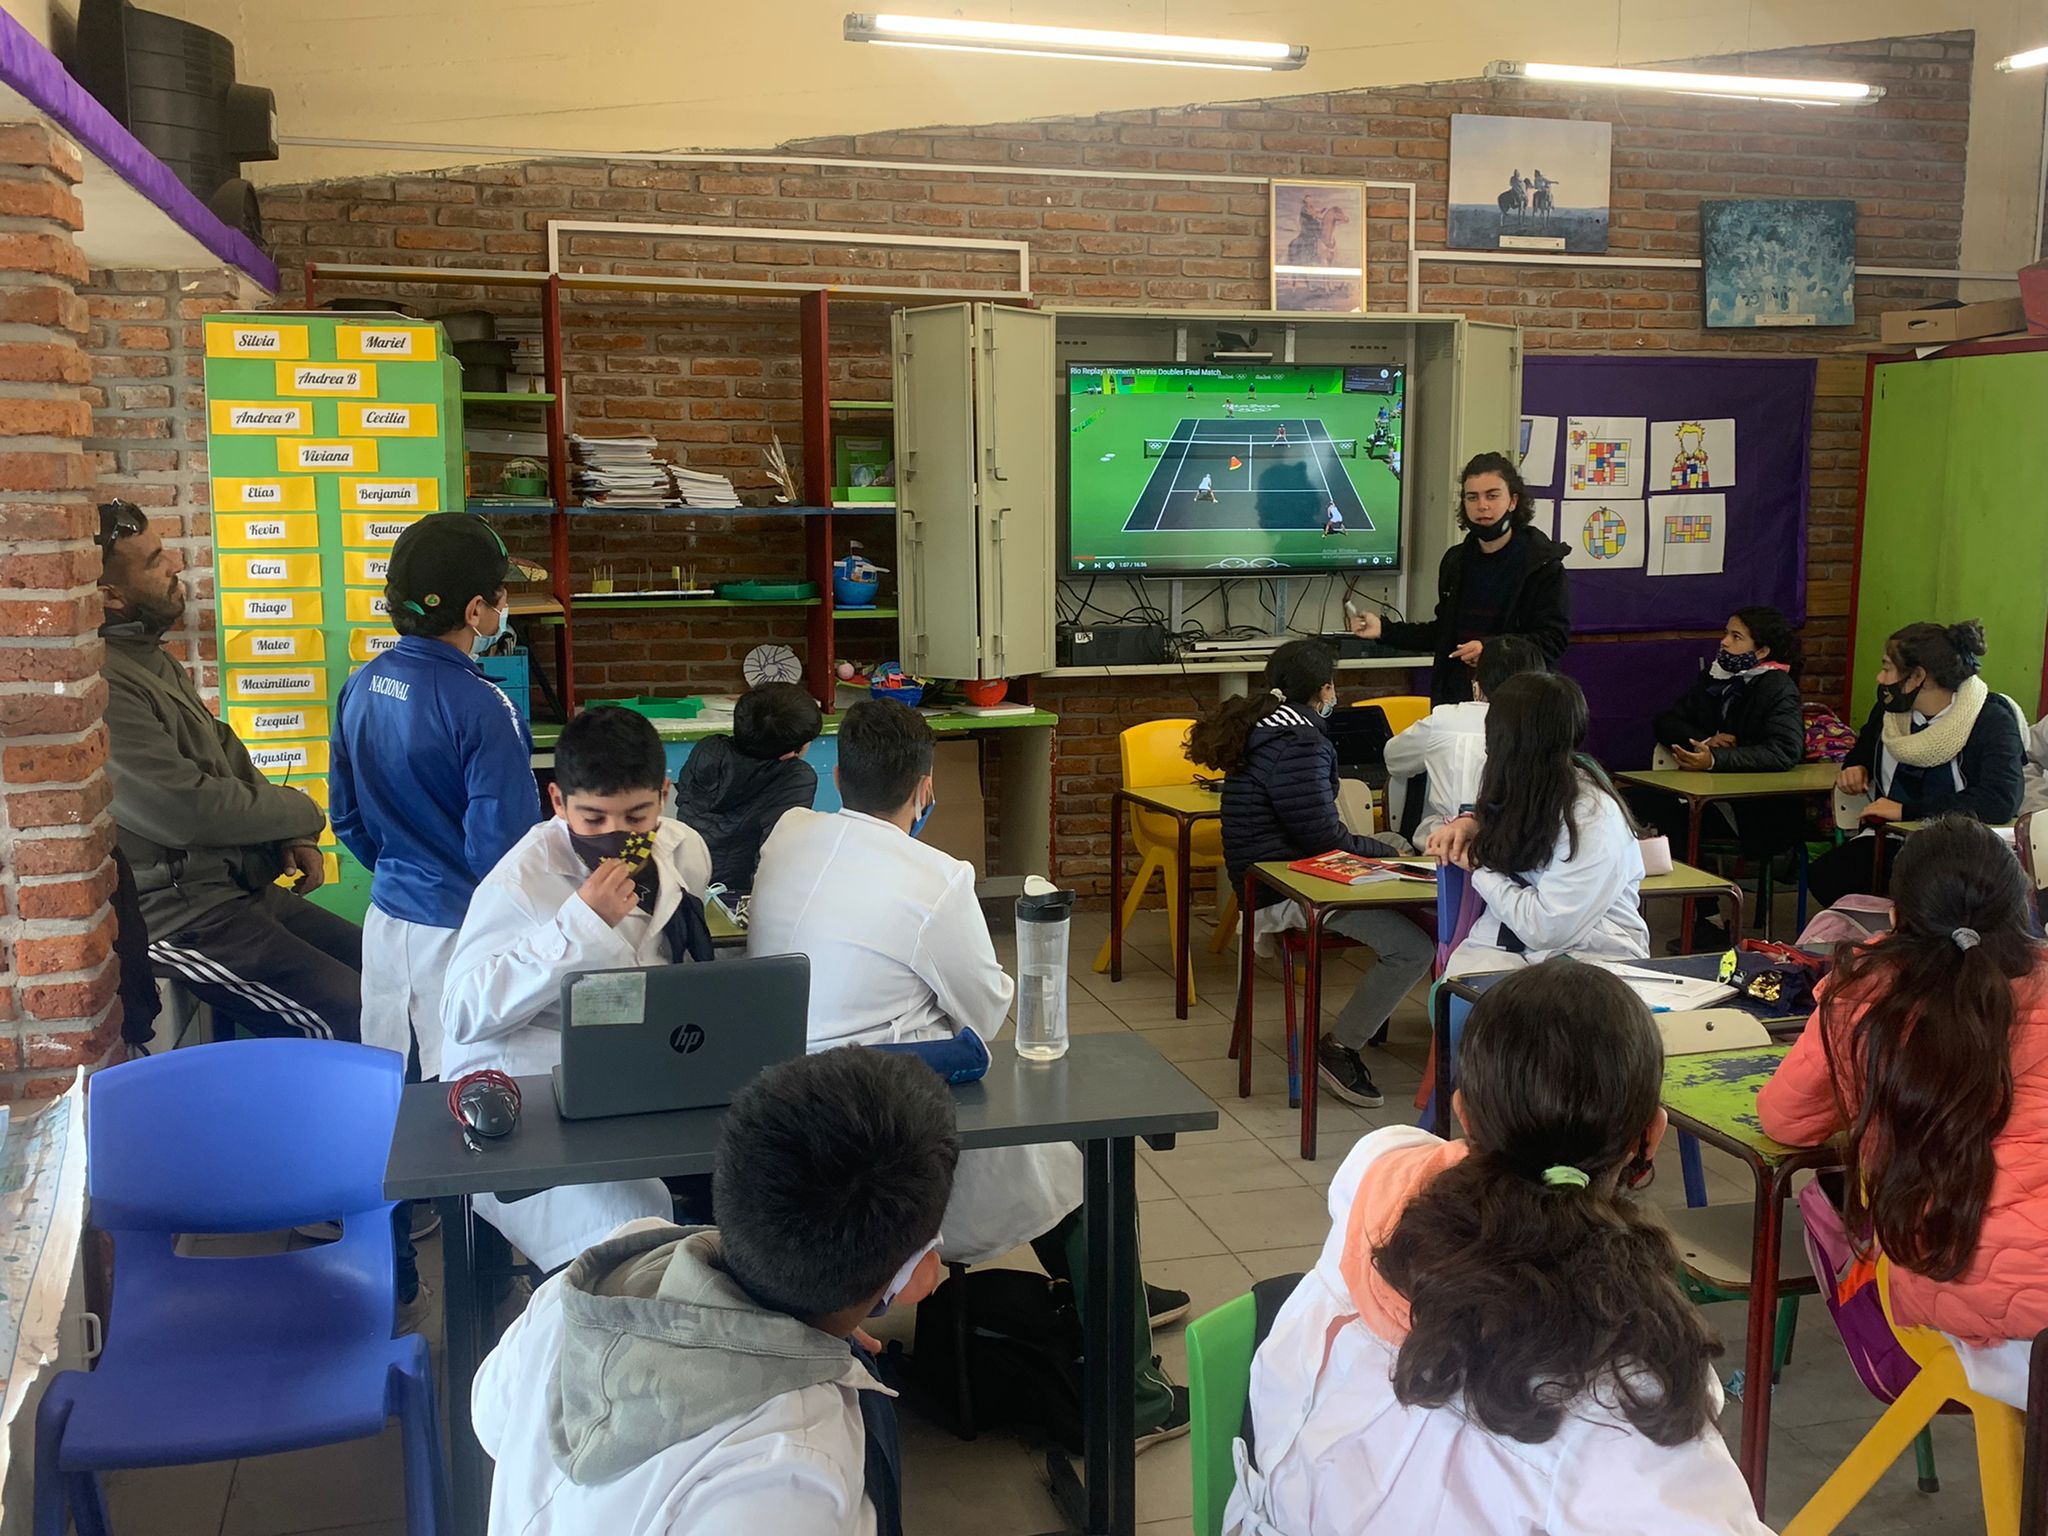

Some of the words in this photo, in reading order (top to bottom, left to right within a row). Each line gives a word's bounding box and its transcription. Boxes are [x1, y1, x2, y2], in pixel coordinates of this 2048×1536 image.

[238, 334, 275, 347] Silvia
[366, 335, 407, 349] Mariel
[298, 371, 344, 385] Andrea
[346, 374, 357, 385] B
[1107, 367, 1135, 375] Women's
[1136, 367, 1157, 375] Tennis
[1158, 367, 1184, 376] Doubles
[1185, 367, 1200, 376] Final
[1201, 367, 1221, 376] Match
[236, 411, 281, 424] Andrea
[284, 412, 295, 424] P
[366, 411, 406, 424] Cecilia
[302, 449, 350, 462] Viviana
[249, 523, 280, 535] Kevin
[250, 563, 281, 575] Clara
[249, 602, 287, 615] Thiago
[257, 639, 290, 651] Mateo
[371, 637, 398, 650] Fran
[242, 677, 311, 690] Maximiliano
[369, 674, 410, 701] NACIONAL
[255, 714, 299, 728] Ezequiel
[252, 751, 301, 765] Agustina
[675, 1025, 701, 1054] hp
